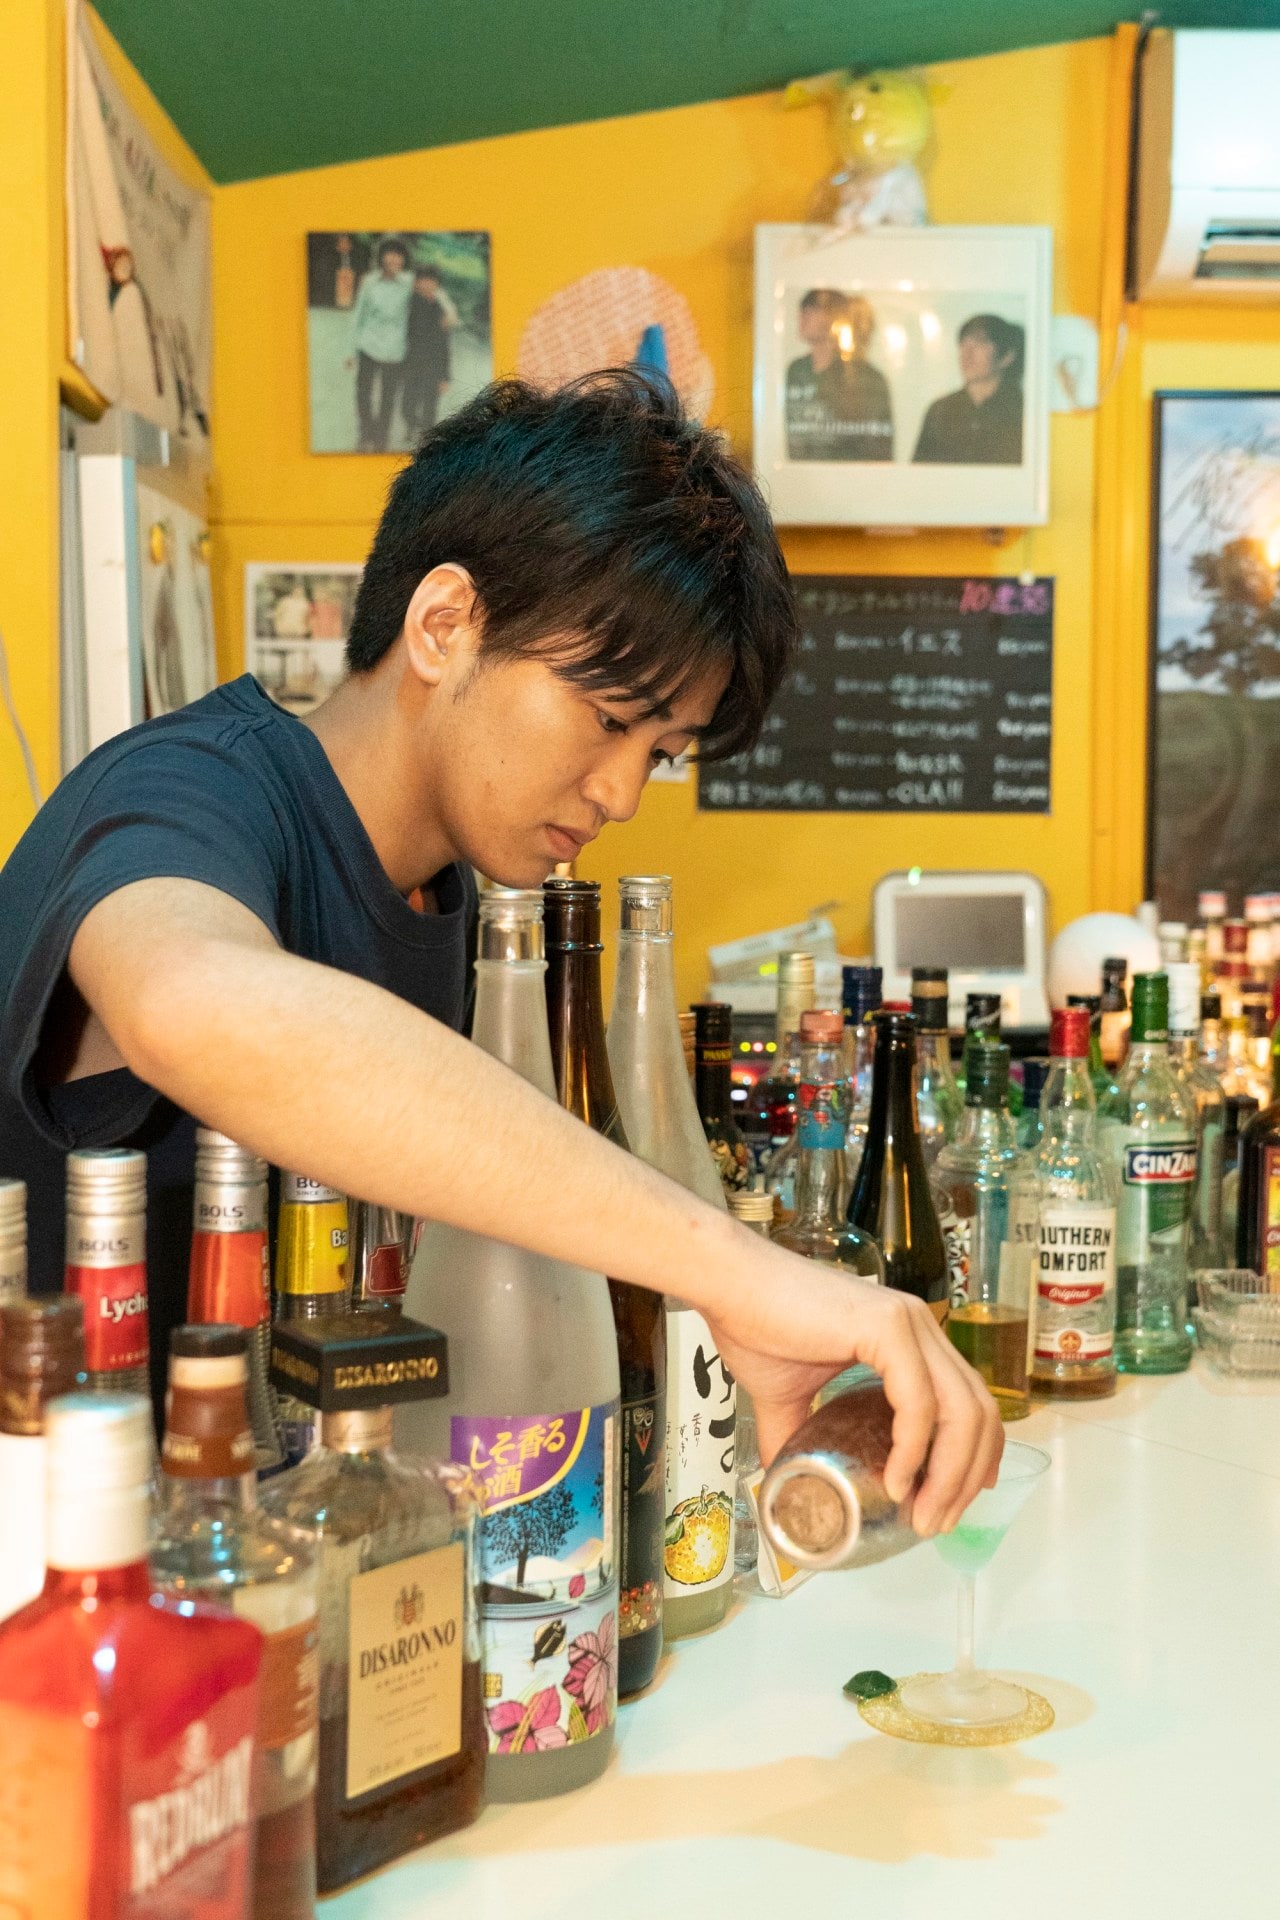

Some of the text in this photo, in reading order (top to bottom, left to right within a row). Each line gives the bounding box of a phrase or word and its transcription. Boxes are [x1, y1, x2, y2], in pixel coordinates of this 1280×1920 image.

[200, 1204, 244, 1218] BOLS
[79, 1238, 130, 1252] BOLS
[333, 1356, 439, 1390] DISARONNO
[470, 1418, 566, 1470] しそ香る
[359, 1619, 456, 1678] DISARONNO
